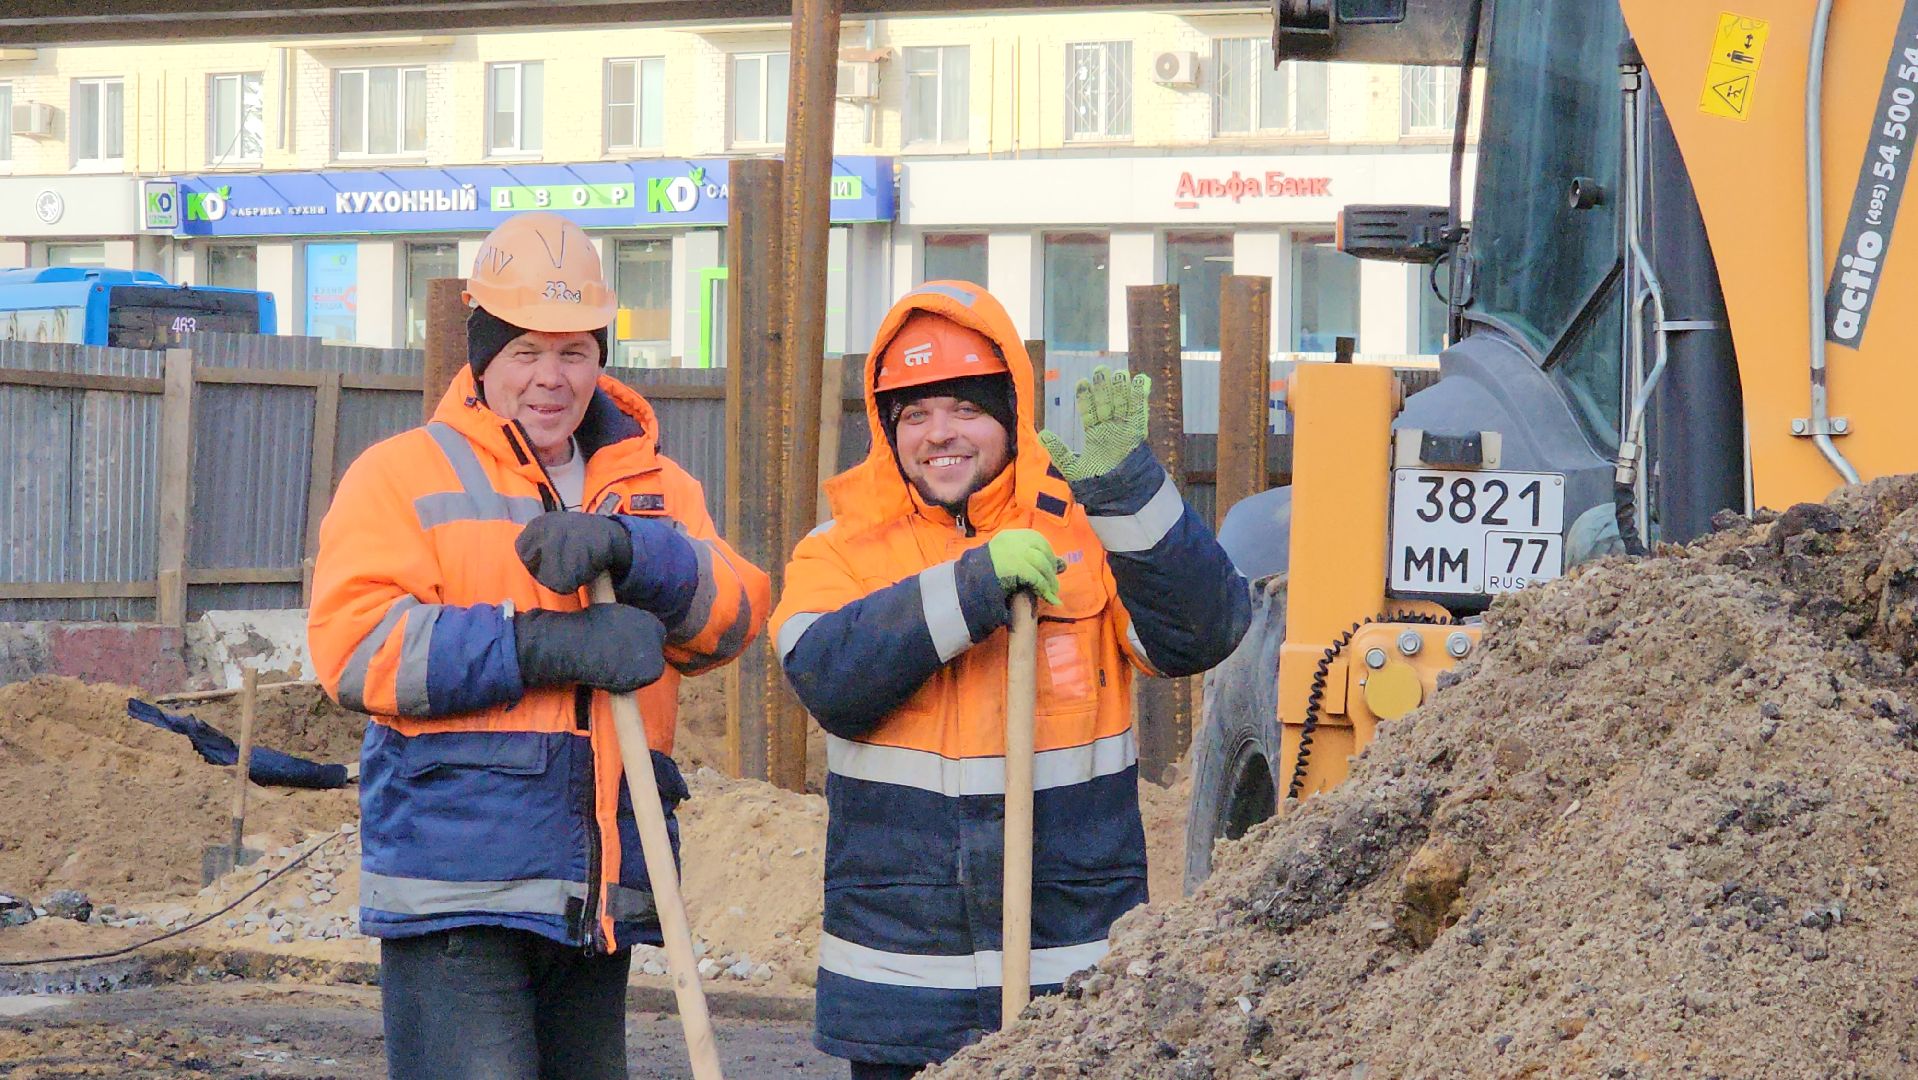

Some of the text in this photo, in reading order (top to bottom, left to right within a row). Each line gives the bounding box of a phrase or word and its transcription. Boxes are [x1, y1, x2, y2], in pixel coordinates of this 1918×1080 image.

[1883, 87, 1915, 141] 500
[1873, 145, 1901, 180] 54
[148, 192, 172, 213] KD
[336, 184, 478, 213] КУХОННЫЙ
[648, 177, 698, 212] KD
[1175, 171, 1332, 203] Альфа Банк
[1865, 184, 1889, 225] (495)
[187, 193, 226, 221] KD
[1833, 231, 1882, 339] actio
[171, 316, 197, 333] 463
[1416, 476, 1541, 527] 3821
[1503, 537, 1549, 575] 77
[1490, 576, 1526, 590] RUS
